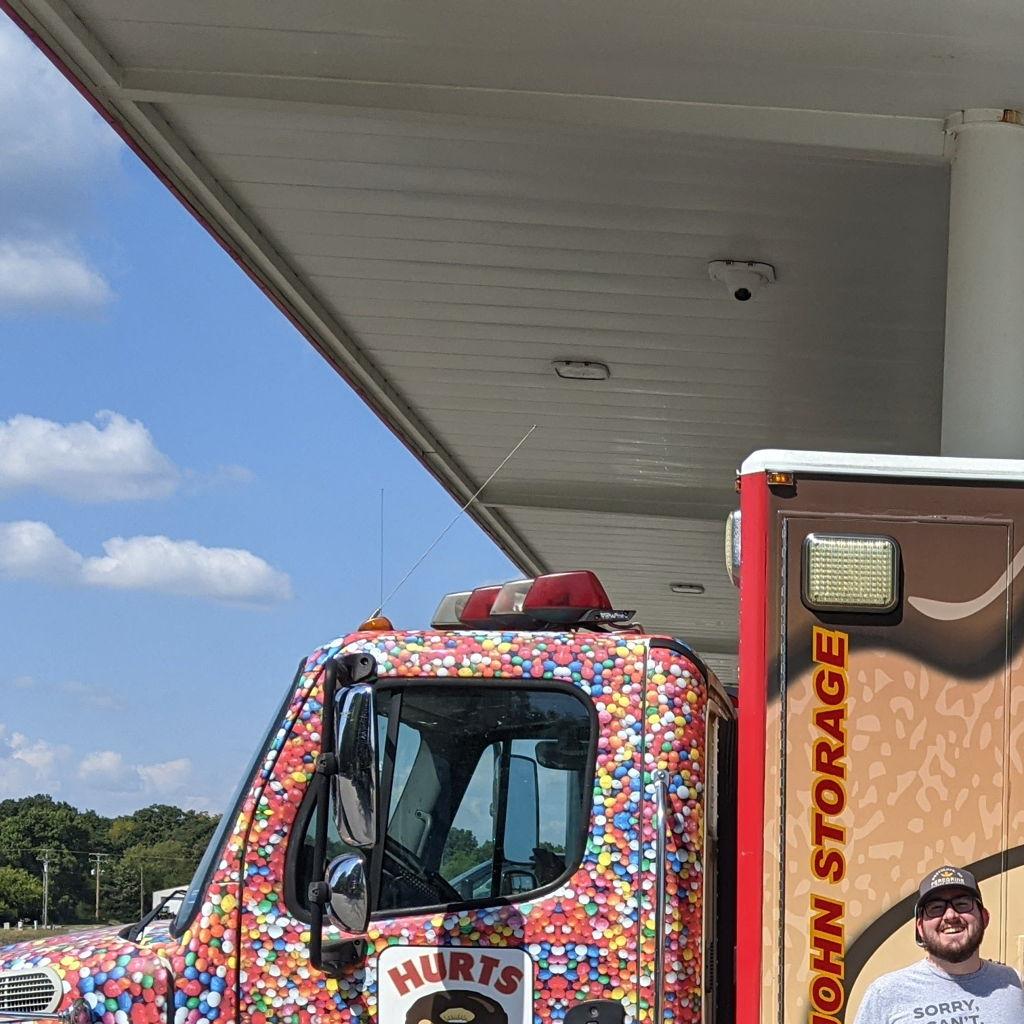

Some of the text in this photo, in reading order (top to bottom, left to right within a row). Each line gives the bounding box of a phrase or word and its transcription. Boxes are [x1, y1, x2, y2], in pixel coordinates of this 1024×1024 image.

[811, 625, 849, 884] STORAGE
[388, 952, 524, 996] HURTS
[913, 999, 980, 1019] SORRY,
